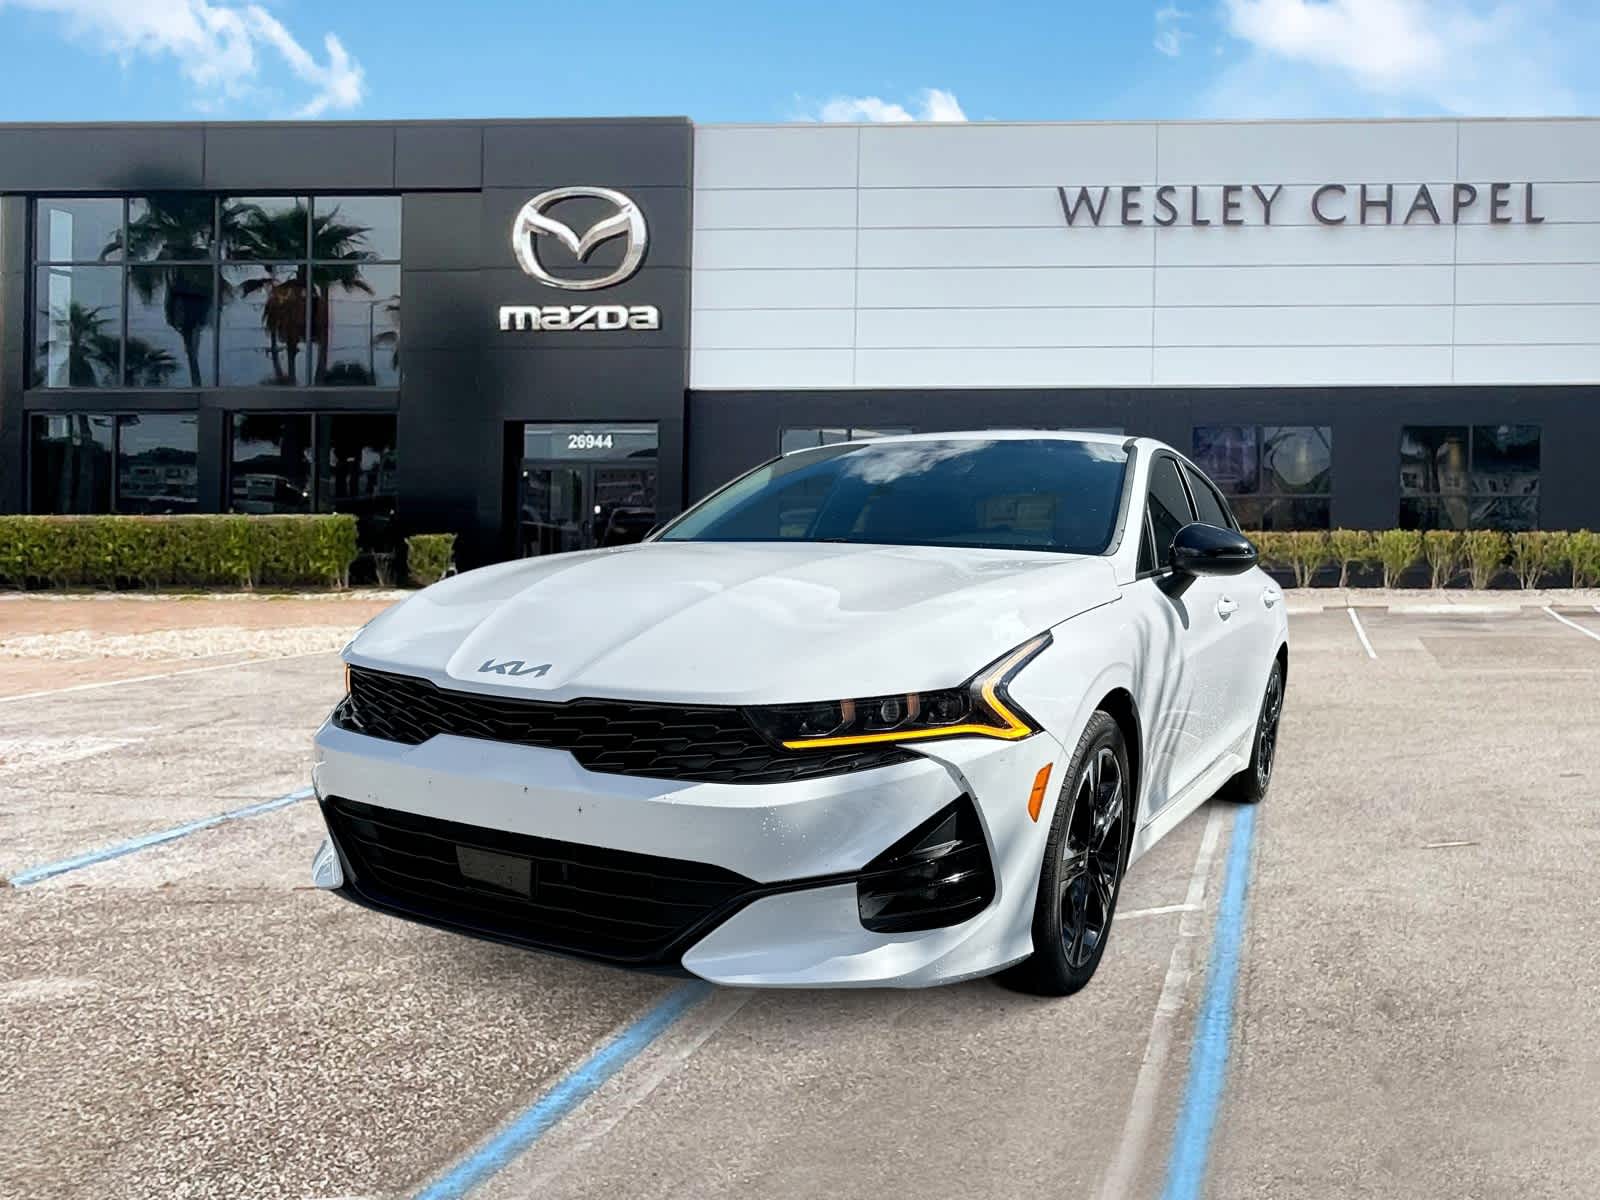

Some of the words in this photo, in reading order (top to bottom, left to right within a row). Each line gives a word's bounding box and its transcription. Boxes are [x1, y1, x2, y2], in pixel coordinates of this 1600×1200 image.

[1057, 184, 1283, 226] WESLEY
[1311, 182, 1545, 225] CHAPEL
[567, 434, 613, 449] 26944
